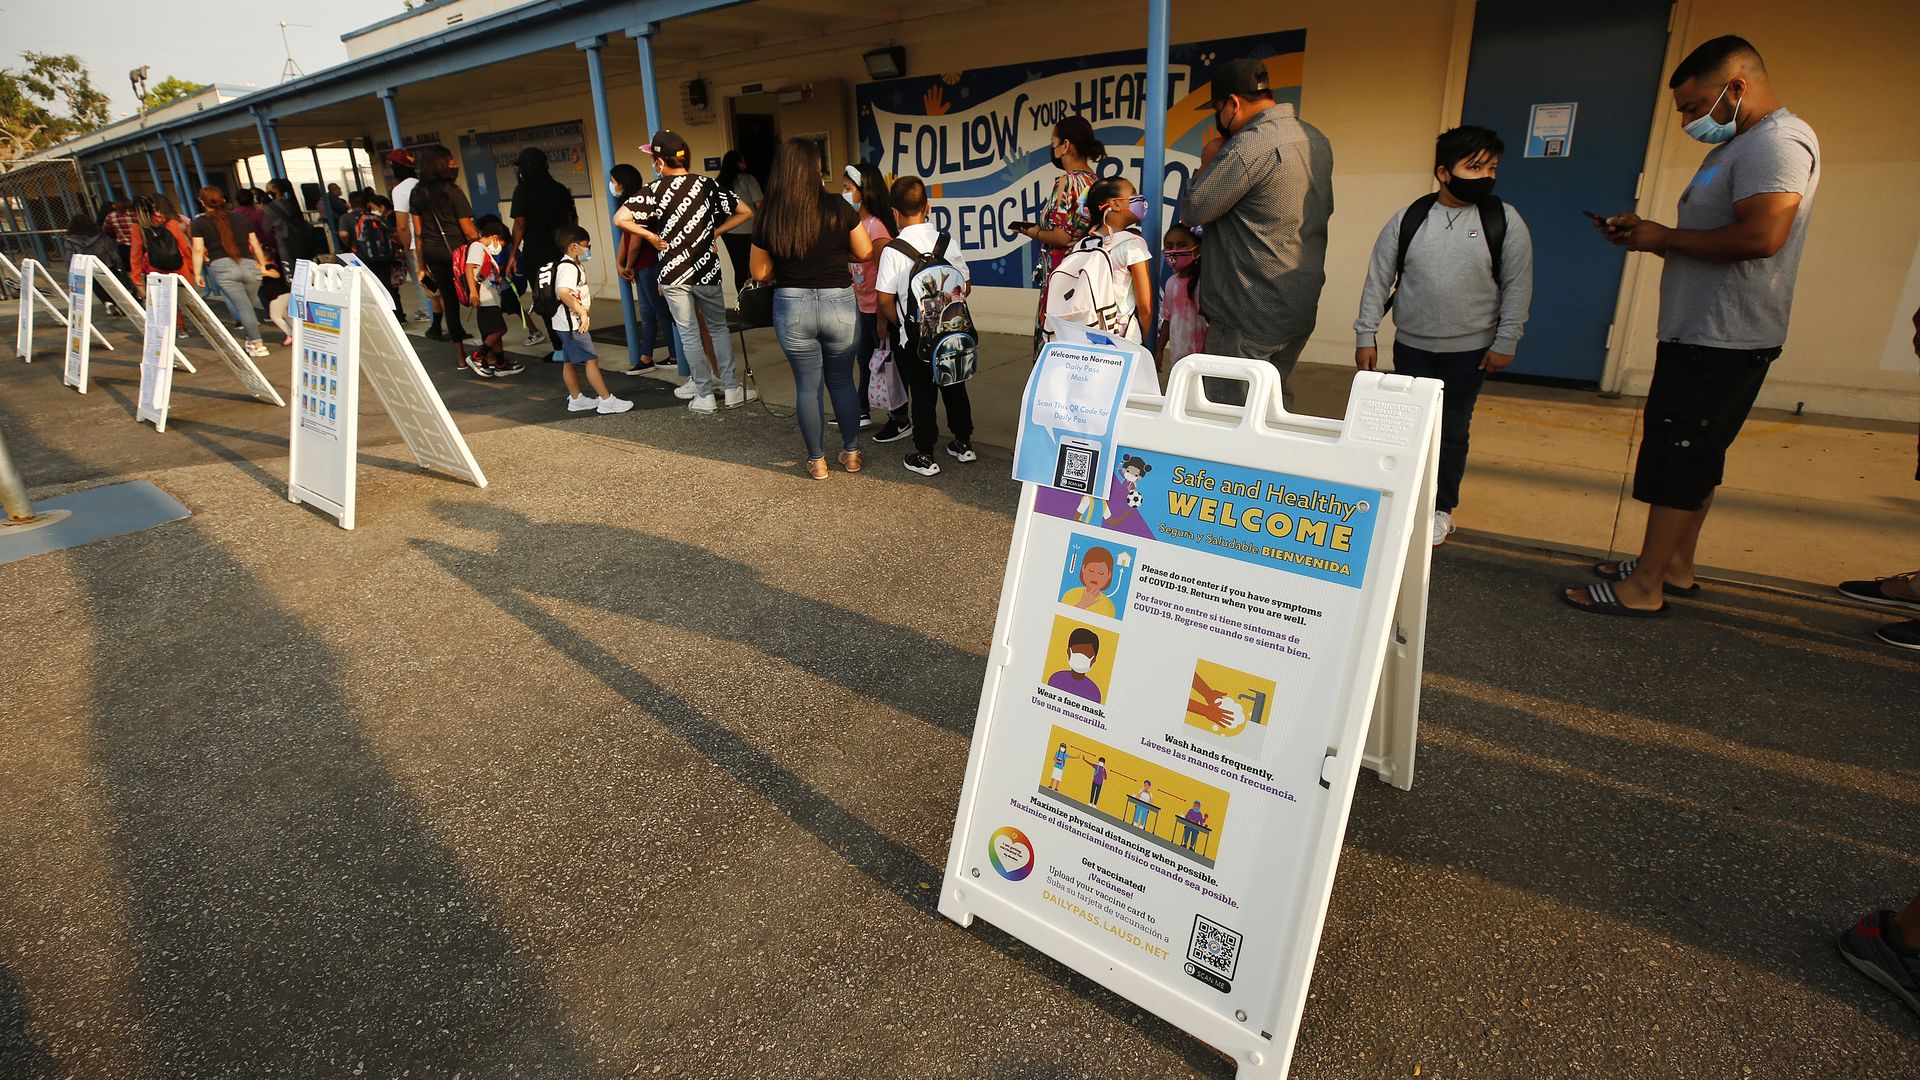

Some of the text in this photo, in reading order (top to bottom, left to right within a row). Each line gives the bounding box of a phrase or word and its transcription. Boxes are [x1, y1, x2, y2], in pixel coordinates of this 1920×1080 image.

[892, 93, 1029, 178] FOLLOW
[1029, 99, 1068, 132] YOUR
[688, 180, 703, 199] NOT
[670, 231, 685, 249] NOT
[1050, 350, 1080, 361] Welcome
[1090, 355, 1122, 366] Normont
[1065, 363, 1099, 373] Daily Pass
[1071, 374, 1089, 382] Mask
[1037, 399, 1110, 417] Scan This QR Code for
[1054, 412, 1087, 424] Daily Pass
[1172, 466, 1357, 522] Safe and Healthy
[1168, 491, 1353, 552] WELCOME
[1158, 523, 1350, 576] Segura y Saludable BIENVENIDA
[1141, 564, 1322, 617] Please do not enter if you have symptoms
[1148, 578, 1189, 594] COVID-19.
[1190, 588, 1220, 603] Return
[1221, 597, 1246, 610] when
[1248, 604, 1265, 615] you
[1266, 609, 1282, 619] are
[1283, 613, 1307, 626] well.
[1133, 602, 1311, 660] COVID-19. Regrese cuando se sienta bien.
[1136, 592, 1150, 602] Por
[1151, 596, 1172, 609] favor
[1174, 603, 1184, 612] no
[1185, 607, 1208, 619] entre
[1219, 615, 1242, 628] tiene
[1243, 622, 1286, 641] síntomas
[1288, 634, 1300, 644] de
[1031, 696, 1107, 731] Use una mascarilla.
[1037, 687, 1056, 700] Wear
[1064, 697, 1081, 709] face
[1082, 705, 1105, 718] mask.
[1140, 736, 1297, 803] Lávese las manos con frecuencia.
[1164, 733, 1274, 782] Wash hands frequently.
[1009, 798, 1048, 822] Maximice
[1048, 816, 1056, 825] el
[1056, 819, 1124, 857] distanciamiento
[1150, 862, 1184, 884] cuando
[1184, 879, 1201, 891] sea
[1202, 886, 1240, 909] posible.
[1029, 796, 1219, 887] Maximize physical distancing when possible.
[1049, 865, 1156, 924] Upload your vaccine card to
[1082, 857, 1146, 893] Get vaccinated!
[1088, 873, 1134, 900] ¡Vacúnese!
[1042, 890, 1169, 961] DAILYPASS.LAUSD.NET
[1046, 876, 1065, 891] Suba
[1066, 887, 1076, 896] su
[1077, 891, 1102, 912] tarjeta
[1104, 904, 1114, 916] de
[1115, 912, 1163, 941] vacunación
[1196, 970, 1225, 990] SCAN ME
